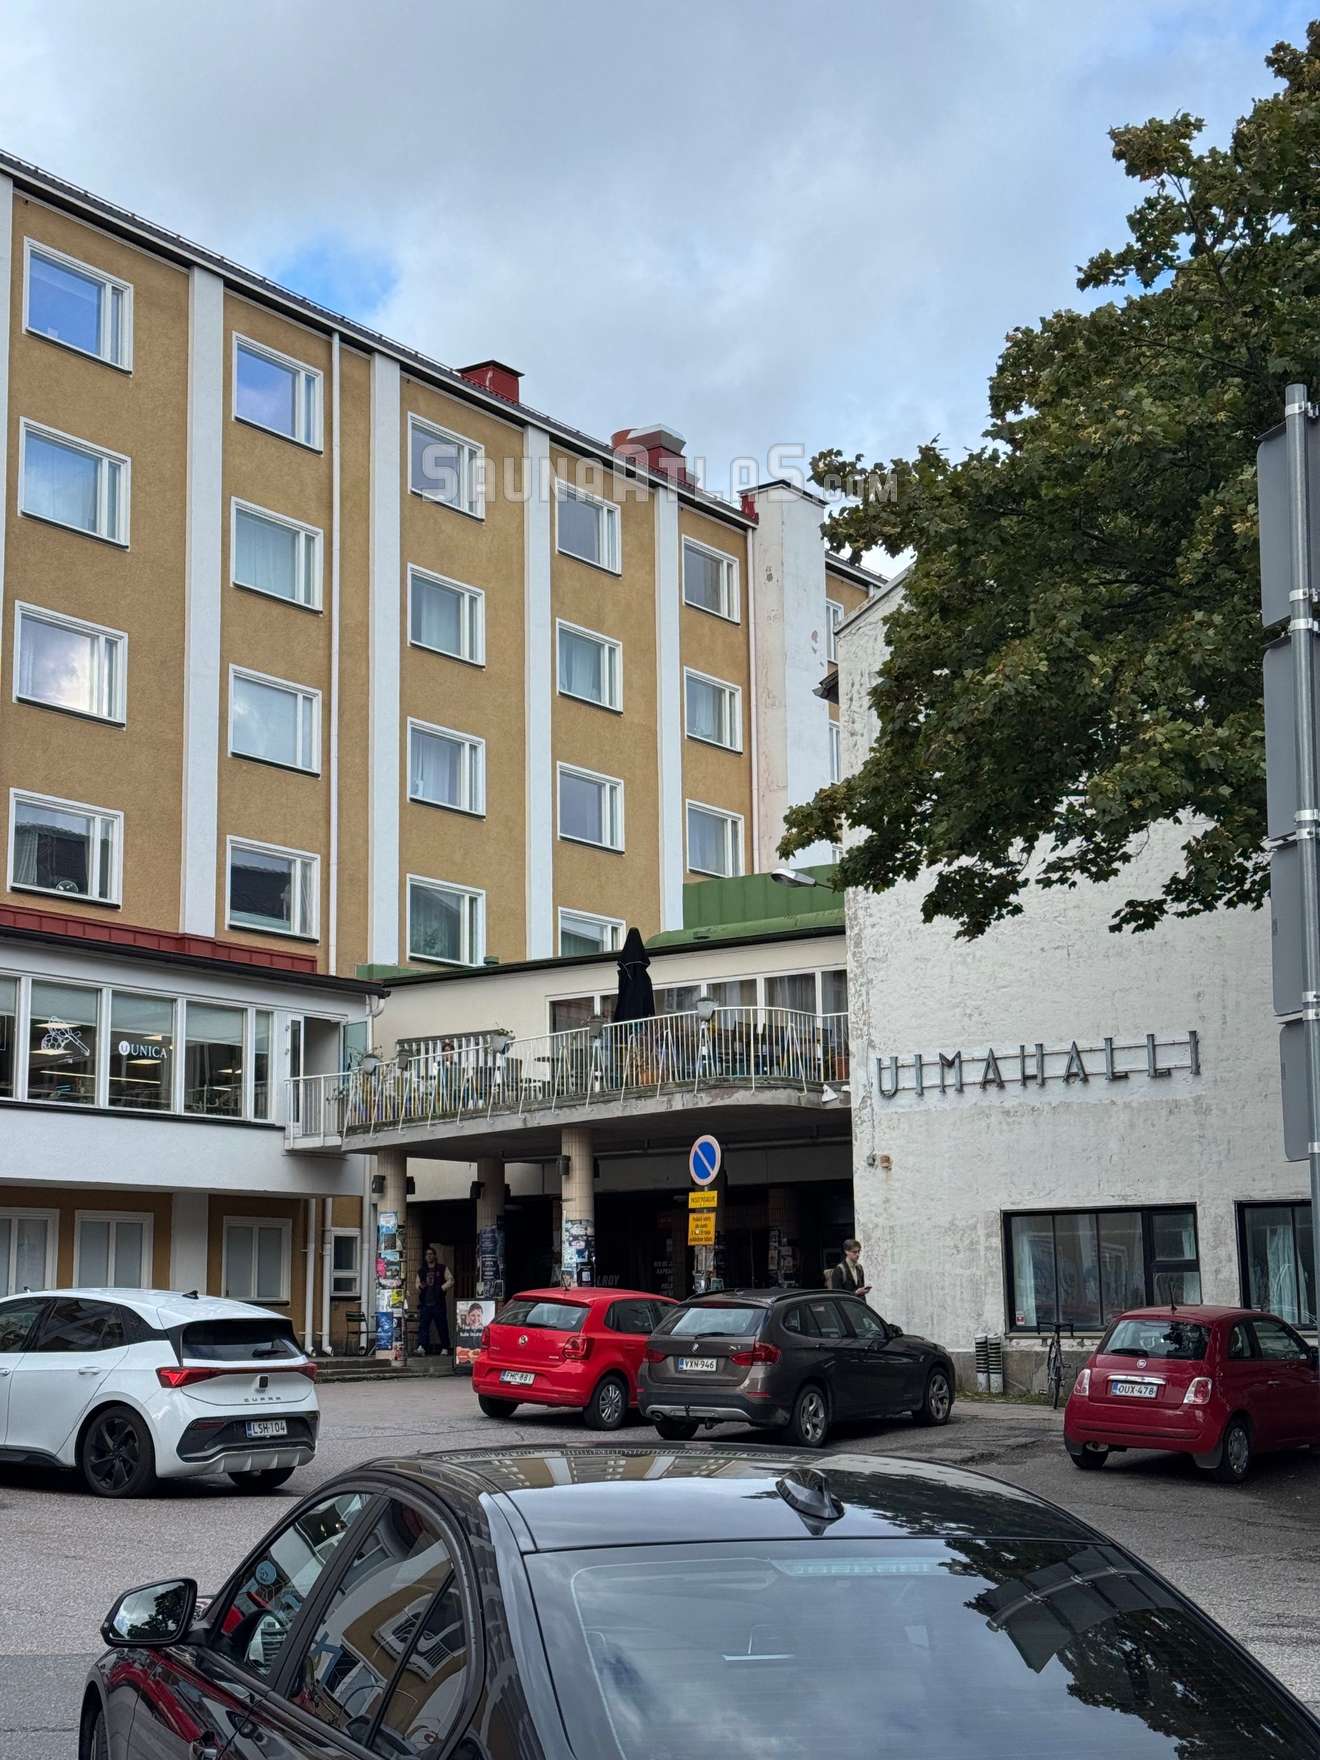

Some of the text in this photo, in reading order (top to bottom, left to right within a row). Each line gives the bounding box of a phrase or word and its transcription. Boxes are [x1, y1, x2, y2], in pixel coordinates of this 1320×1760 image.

[131, 1044, 167, 1058] UNICA
[876, 1030, 1200, 1097] UIMAHALLI
[685, 1361, 715, 1370] VXN-946
[1117, 1384, 1155, 1396] OUX-478
[253, 1421, 286, 1435] LSH-104
